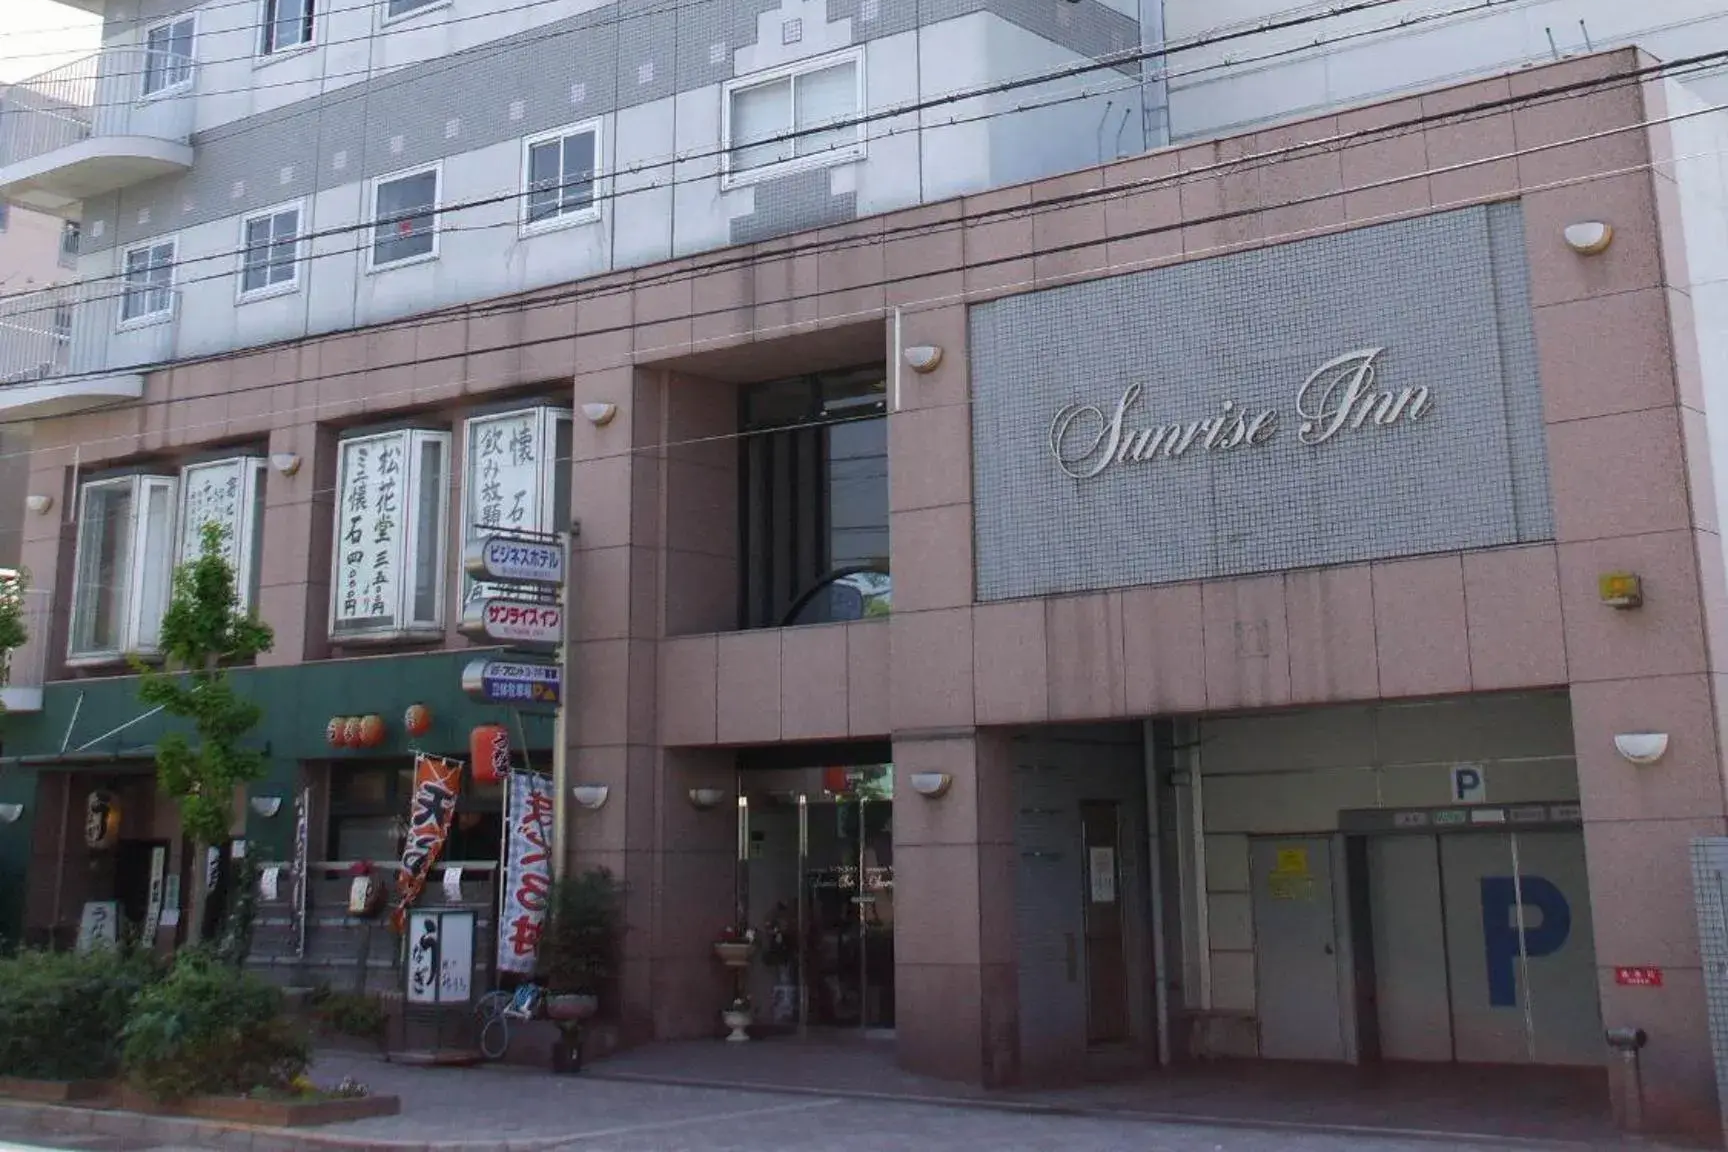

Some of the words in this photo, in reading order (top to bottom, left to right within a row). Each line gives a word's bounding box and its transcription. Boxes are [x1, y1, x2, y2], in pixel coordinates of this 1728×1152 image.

[1050, 382, 1277, 479] Sunrise
[1297, 347, 1432, 445] Inn
[490, 545, 559, 569] ビジネスホテル
[1455, 768, 1481, 799] P
[1480, 875, 1571, 1006] P
